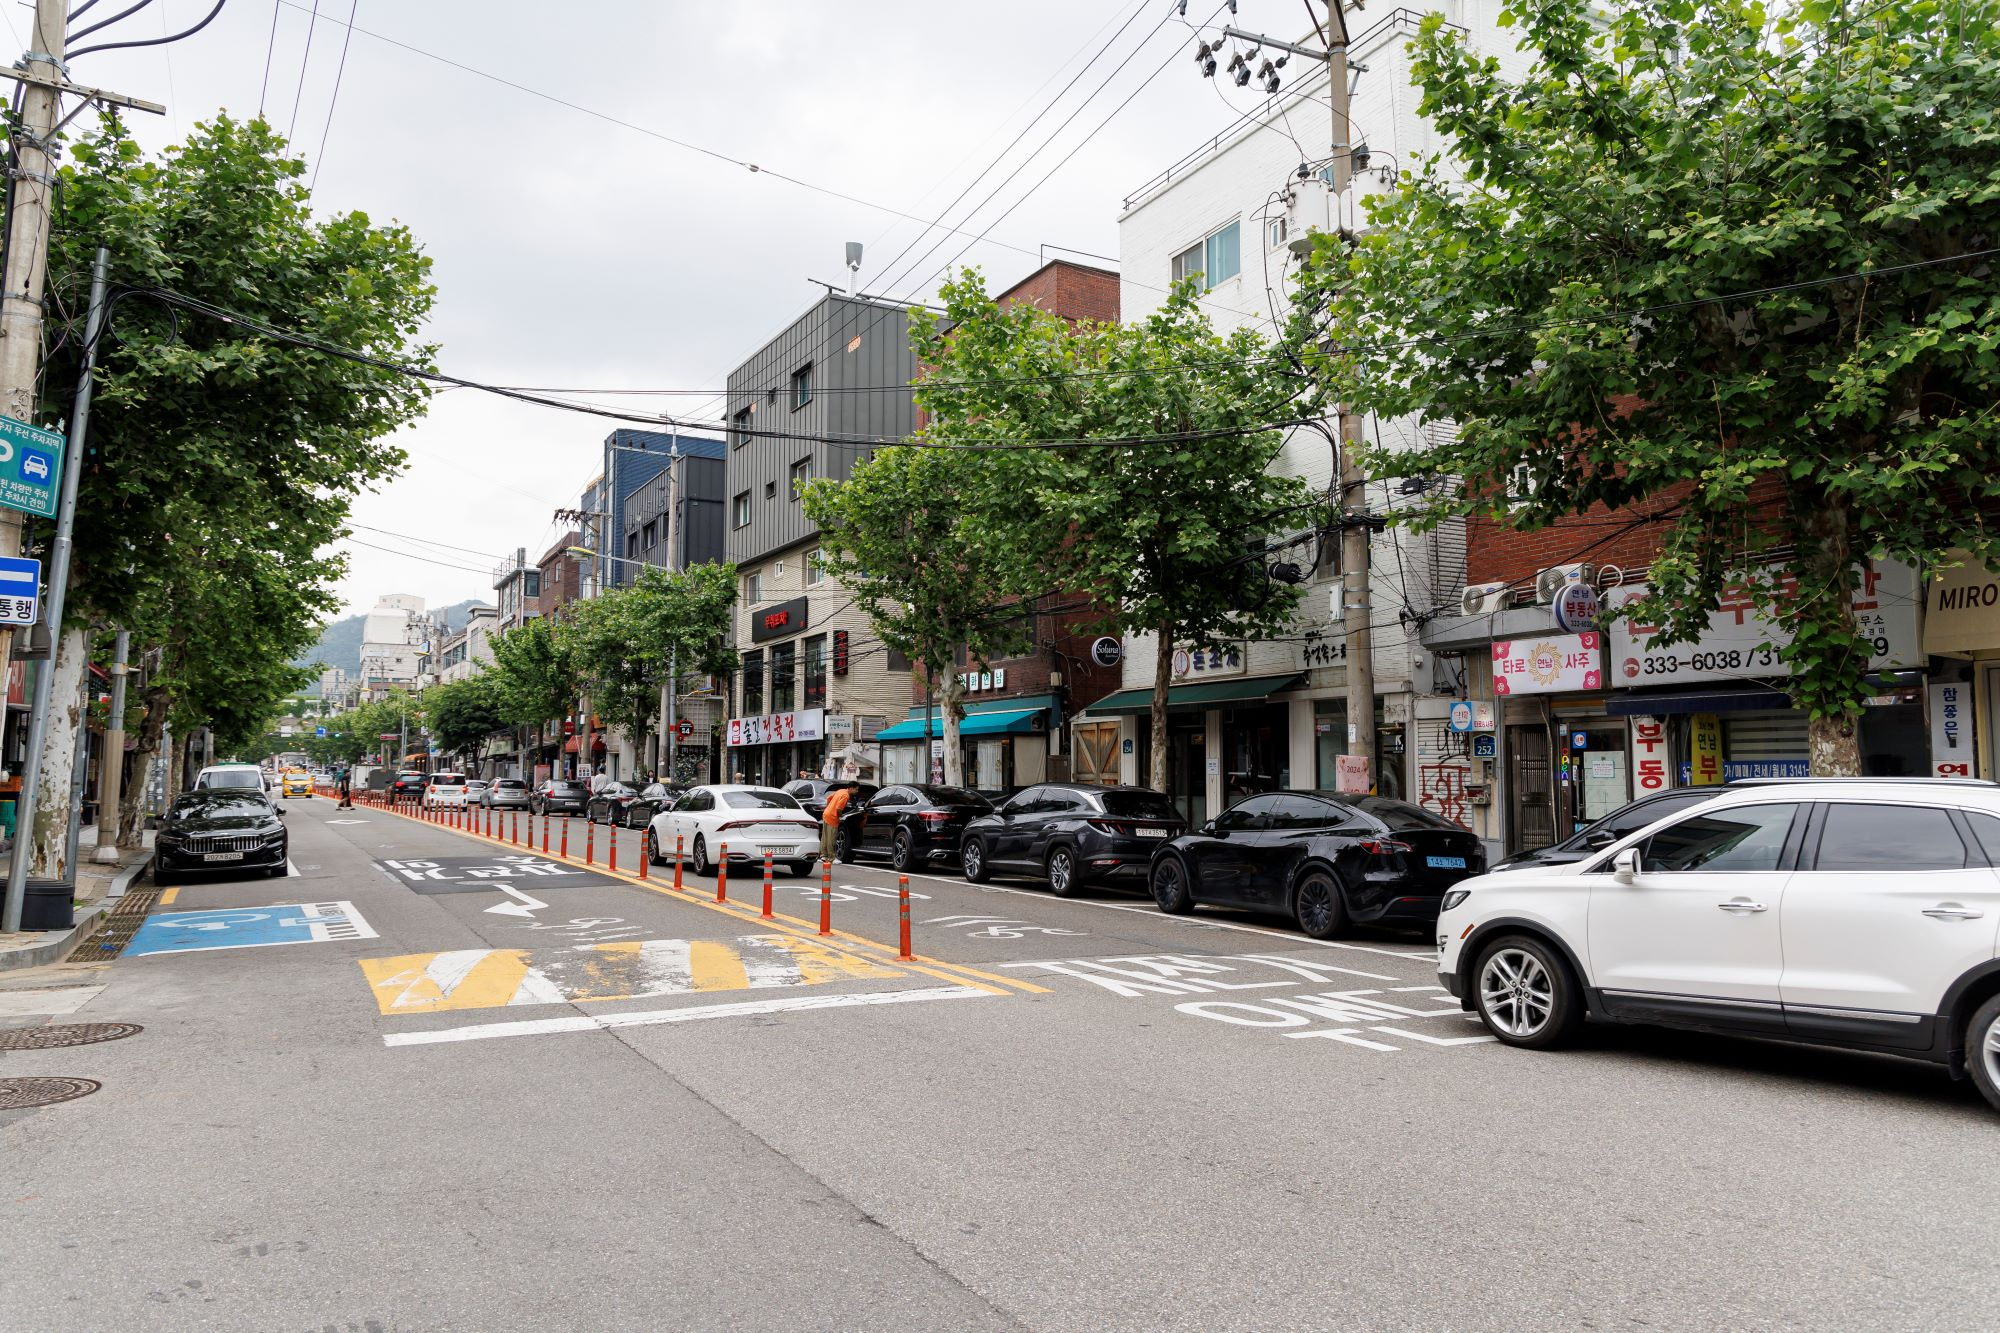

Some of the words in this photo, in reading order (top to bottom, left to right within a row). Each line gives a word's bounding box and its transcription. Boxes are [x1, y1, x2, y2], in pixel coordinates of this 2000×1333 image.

[15, 426, 29, 439] 우선
[31, 431, 60, 448] 주차지역
[10, 482, 33, 495] 차량만
[34, 488, 49, 500] 주차
[1571, 589, 1589, 598] 연남
[1939, 584, 1999, 612] MIRO
[1566, 601, 1596, 617] 부동산
[1097, 643, 1119, 654] Soluna
[1503, 659, 1525, 674] 타로
[1537, 658, 1553, 669] 연남
[1565, 652, 1590, 669] 사주
[1644, 650, 1741, 675] 333-6038
[1477, 745, 1492, 755] 252
[1698, 733, 1717, 750] 연남
[1346, 765, 1361, 774] 2024
[999, 953, 1401, 997] 자전거
